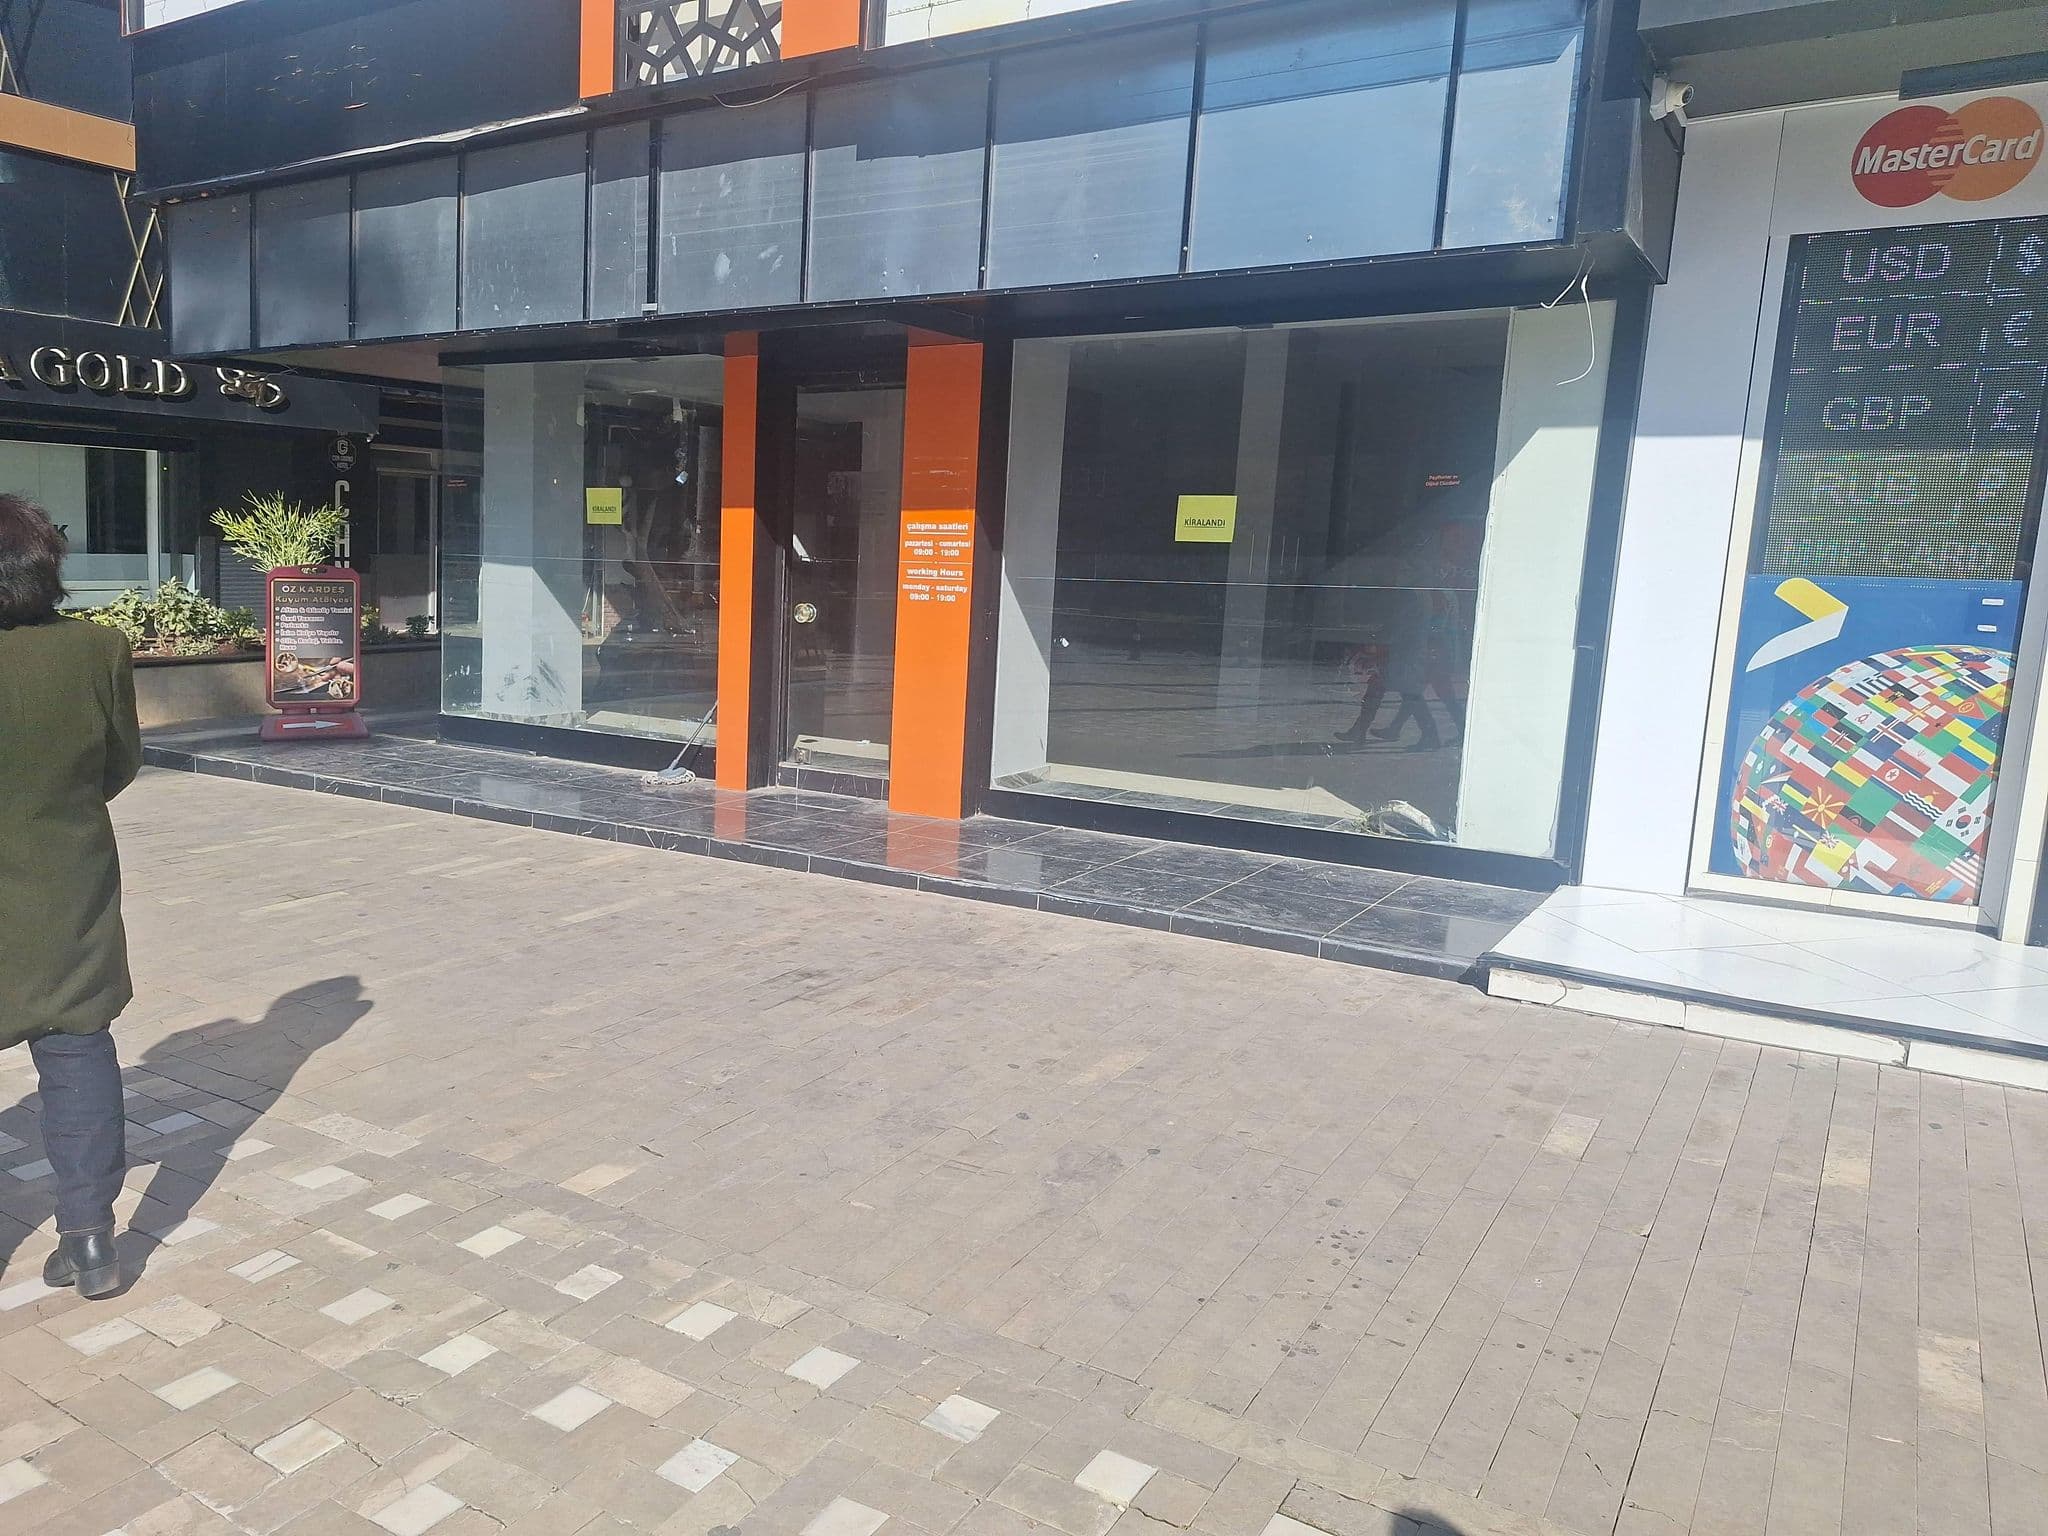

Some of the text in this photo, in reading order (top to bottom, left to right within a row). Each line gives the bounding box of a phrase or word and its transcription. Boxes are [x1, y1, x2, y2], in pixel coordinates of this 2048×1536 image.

[1854, 128, 2042, 176] MasterCard
[1842, 243, 1951, 283] USD
[1832, 311, 1941, 351] EUR
[30, 346, 190, 395] GOLD
[1822, 394, 1932, 431] GBP
[1811, 470, 1919, 506] RUB
[906, 568, 964, 578] working Hours
[1881, 538, 1995, 572] CARD
[902, 583, 930, 592] monday
[936, 584, 968, 593] saturday
